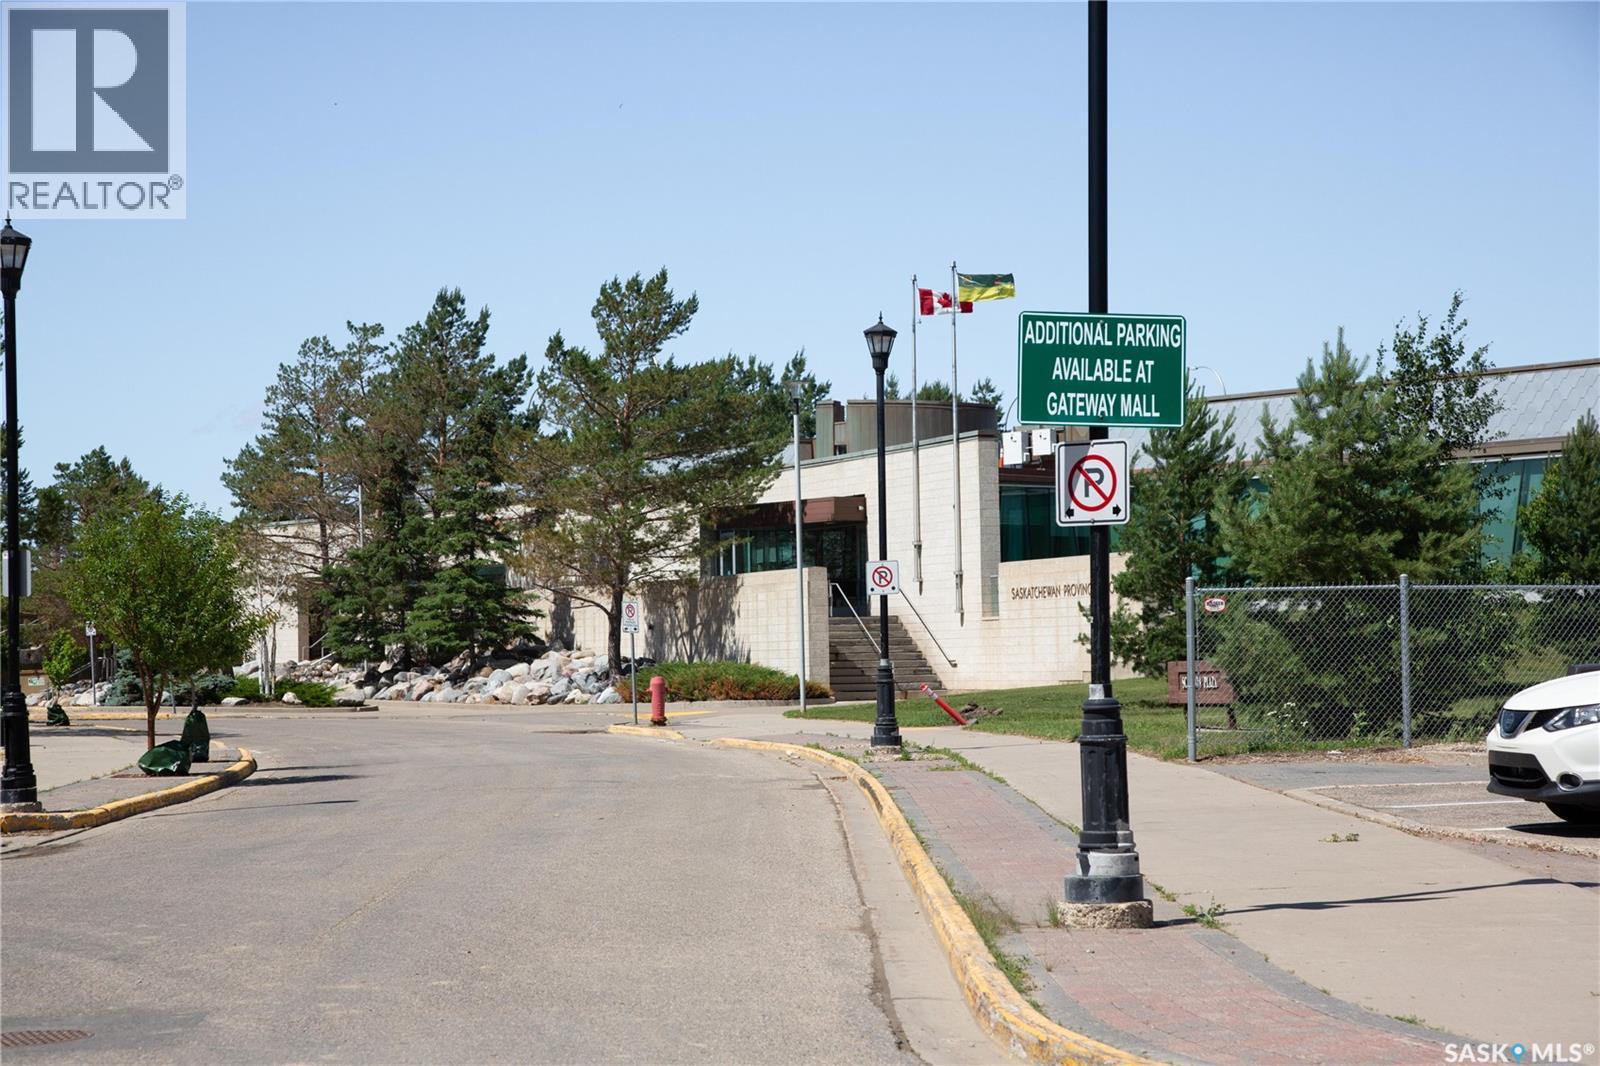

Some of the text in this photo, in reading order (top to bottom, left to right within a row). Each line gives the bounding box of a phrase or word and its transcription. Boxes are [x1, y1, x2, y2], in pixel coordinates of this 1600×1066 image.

[1024, 320, 1181, 348] ADDITIONAL PARKING
[1052, 357, 1154, 383] AVAILABLE AT
[1046, 391, 1160, 417] GATEWAY MALL
[1011, 583, 1091, 600] SASKATCHEWAN PROVINC
